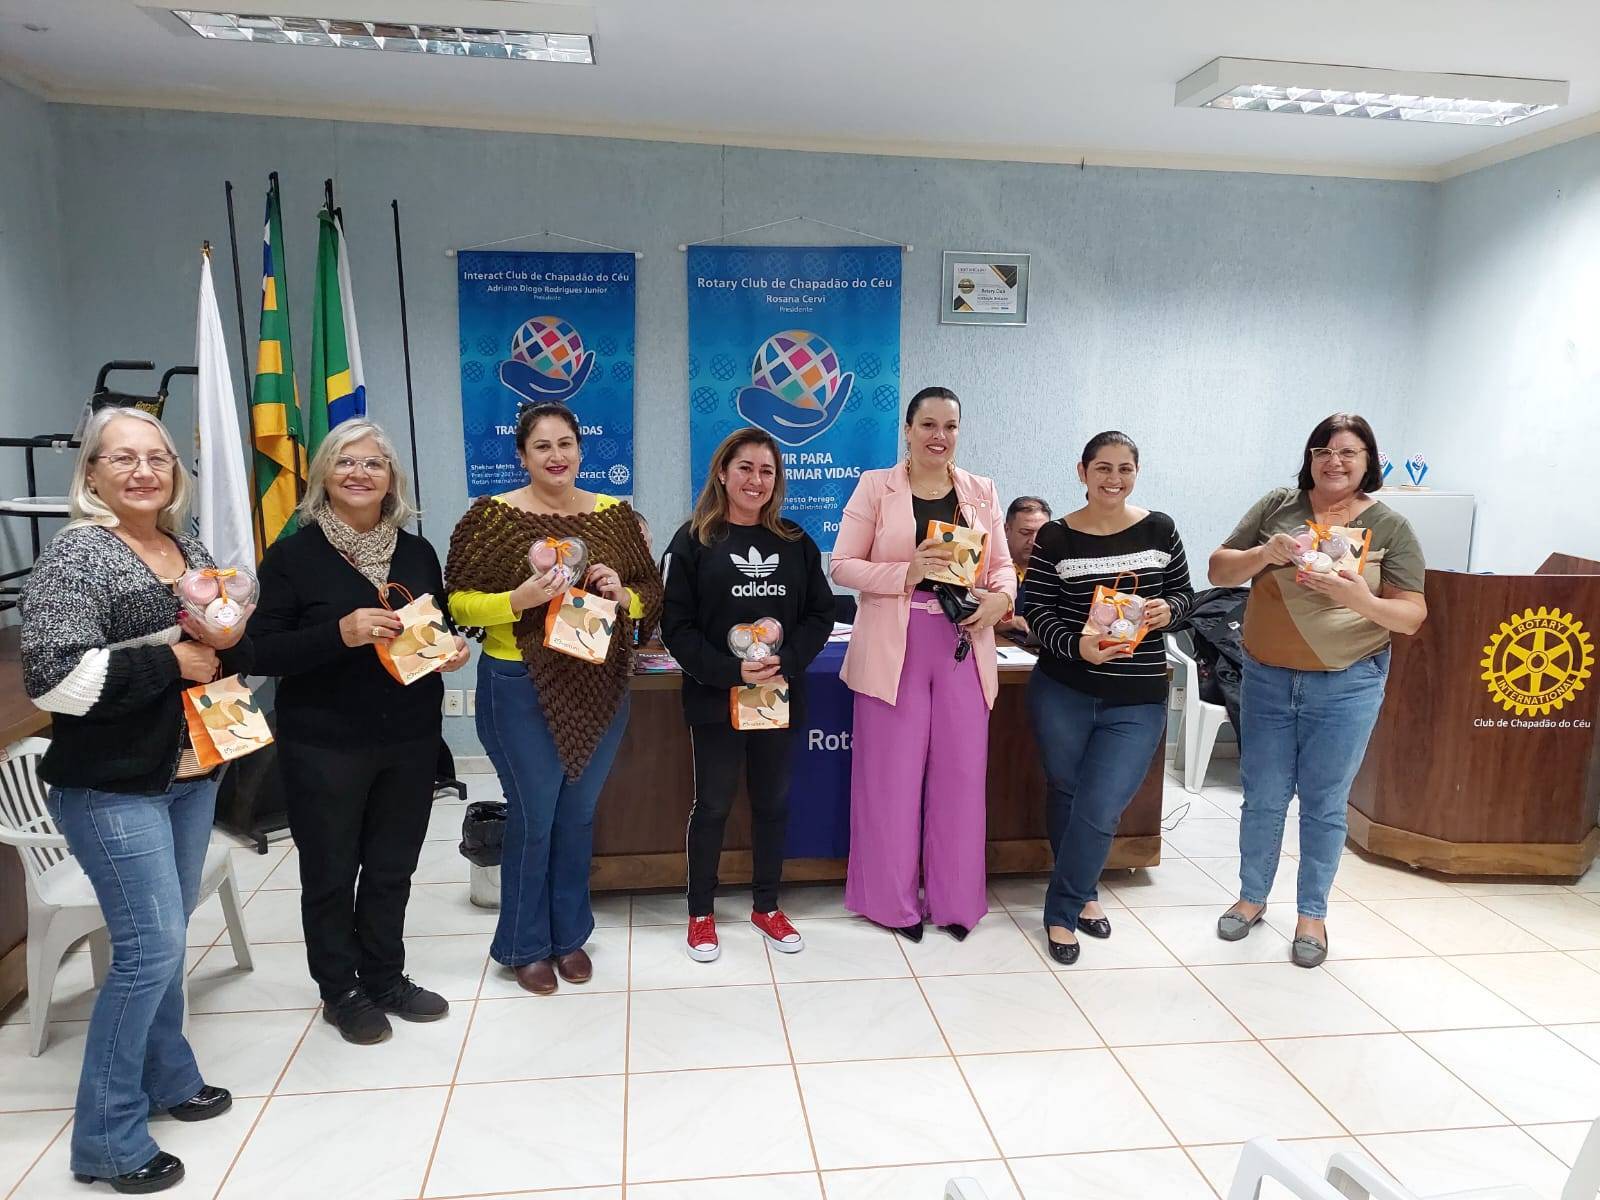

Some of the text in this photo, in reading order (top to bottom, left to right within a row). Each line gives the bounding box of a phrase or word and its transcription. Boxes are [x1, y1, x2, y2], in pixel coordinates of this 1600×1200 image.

[463, 270, 630, 282] Interact Club de Chapadão do Céu
[487, 284, 608, 295] Adriano Diogo Rodrigues Junior
[697, 276, 893, 291] Rotary Club de Chapadão do Céu
[766, 294, 826, 303] Rosana Cervi
[579, 425, 604, 436] IDAS
[800, 452, 833, 465] PARA
[783, 466, 861, 480] RMAR VIDAS
[784, 495, 835, 504] nesto Perego
[823, 521, 841, 533] Ro
[731, 580, 787, 597] adidas
[1517, 619, 1565, 633] ROTARY
[1498, 677, 1576, 705] INTERNATIONAL
[1473, 718, 1591, 730] Club de Chapadão do Céu
[808, 729, 853, 751] Rot
